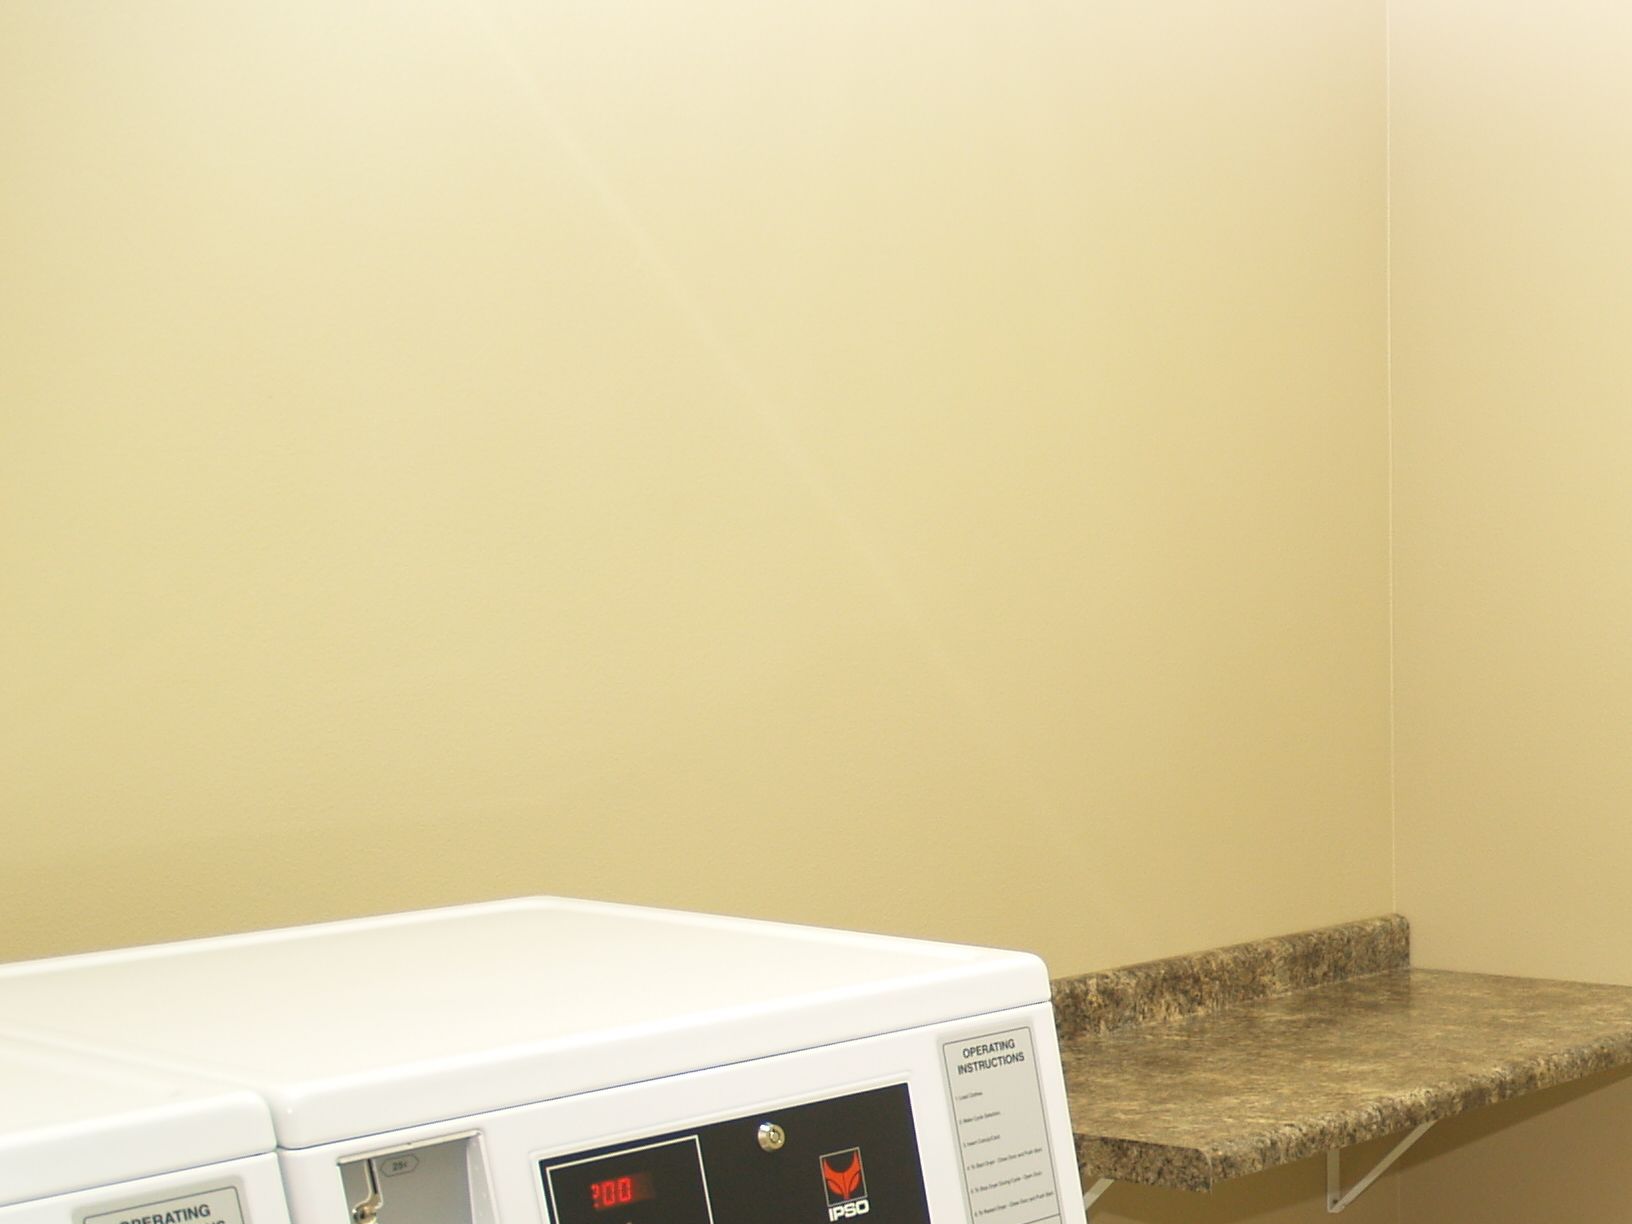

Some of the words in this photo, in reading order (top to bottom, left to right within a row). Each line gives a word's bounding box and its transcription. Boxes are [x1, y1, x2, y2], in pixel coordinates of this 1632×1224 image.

[962, 1038, 1015, 1058] OPERATING
[957, 1051, 1025, 1075] INSTRUCTIONS
[828, 1199, 869, 1222] IPSO
